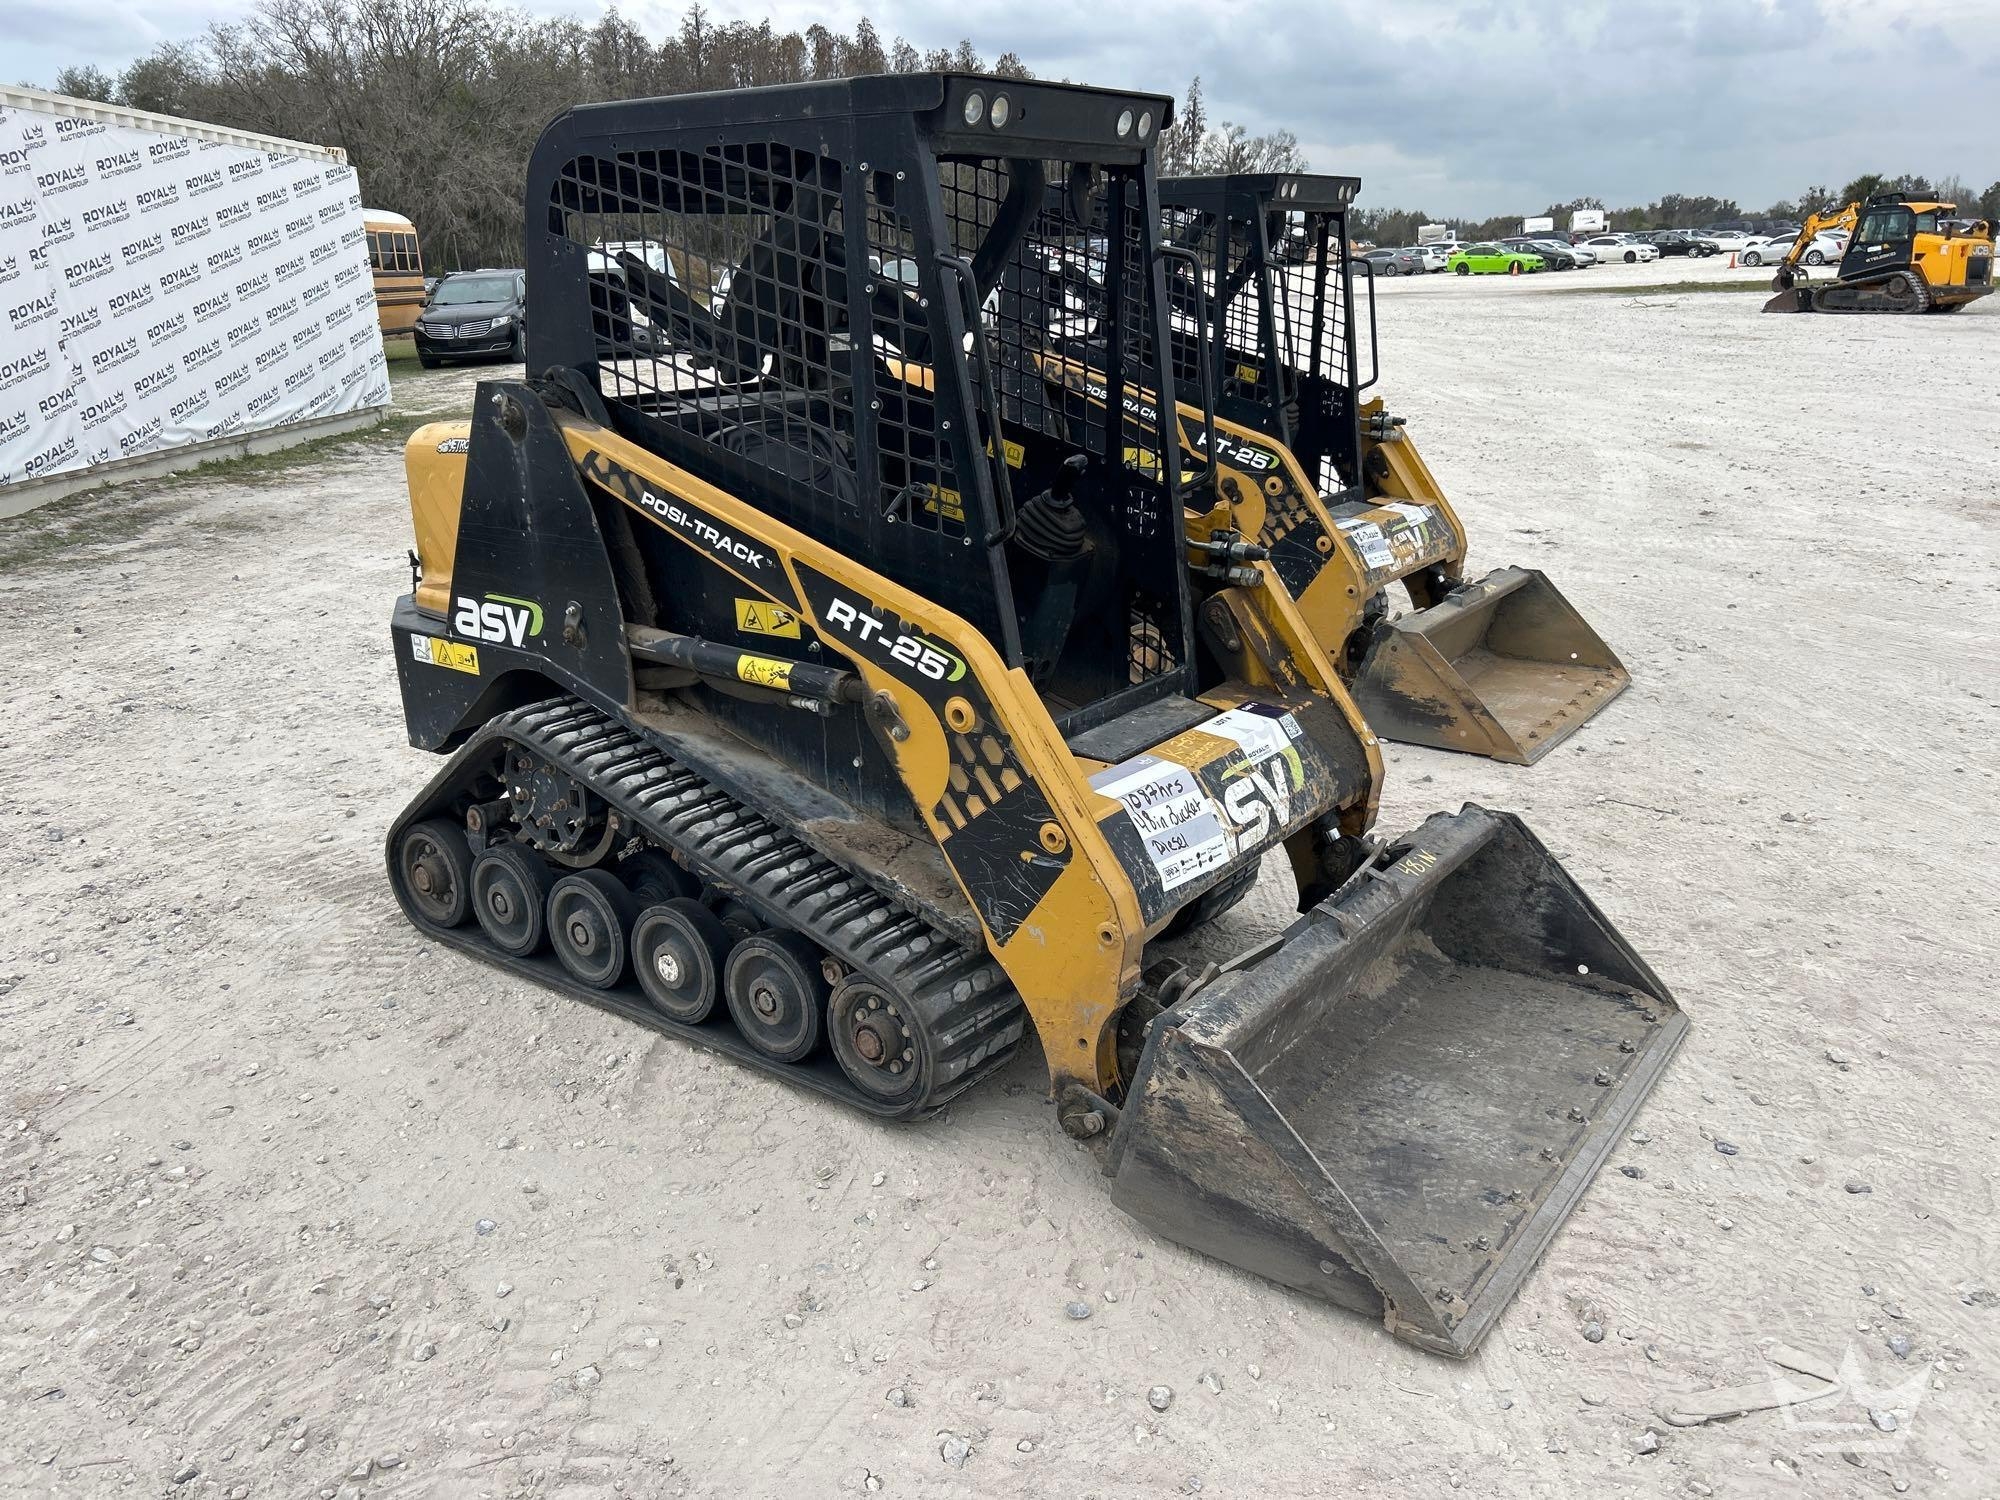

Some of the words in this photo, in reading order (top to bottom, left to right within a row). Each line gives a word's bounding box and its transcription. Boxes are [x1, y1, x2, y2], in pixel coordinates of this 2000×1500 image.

[60, 131, 86, 142] AUCTION
[87, 126, 106, 134] GROUP
[149, 140, 180, 156] ROYAL
[152, 154, 174, 164] AUCTION
[174, 150, 190, 158] GROUP
[96, 153, 131, 172] ROYAL
[100, 168, 124, 180] AUCTION
[124, 163, 142, 172] GROUP
[228, 159, 256, 176] ROYAL
[37, 168, 76, 188] ROYAL
[186, 172, 215, 190] ROYAL
[325, 165, 347, 180] ROYAL
[42, 185, 69, 198] AUCTION
[69, 178, 88, 189] GROUP
[190, 186, 209, 198] AUCTION
[209, 181, 224, 190] GROUP
[293, 177, 314, 192] ROYAL
[136, 187, 170, 206] ROYAL
[140, 201, 163, 214] AUCTION
[163, 196, 180, 205] GROUP
[257, 189, 282, 206] ROYAL
[16, 213, 36, 226] GROUP
[83, 203, 120, 224] ROYAL
[216, 204, 244, 221] ROYAL
[318, 204, 340, 218] ROYAL
[1838, 215, 1852, 224] JCB
[88, 219, 112, 232] AUCTION
[112, 212, 130, 223] GROUP
[170, 220, 202, 238] ROYAL
[286, 218, 310, 233] ROYAL
[54, 232, 75, 244] GROUP
[175, 233, 196, 246] AUCTION
[196, 228, 212, 237] GROUP
[248, 232, 274, 250] ROYAL
[341, 229, 361, 244] ROYAL
[122, 237, 154, 258] ROYAL
[126, 252, 148, 266] AUCTION
[149, 246, 165, 257] GROUP
[310, 244, 332, 259] ROYAL
[1972, 245, 1989, 255] JCB
[208, 248, 234, 268] ROYAL
[275, 259, 300, 276] ROYAL
[64, 258, 102, 280] ROYAL
[69, 273, 95, 288] AUCTION
[95, 266, 114, 278] GROUP
[160, 267, 192, 288] ROYAL
[334, 267, 356, 282] ROYAL
[164, 281, 185, 294] AUCTION
[185, 275, 202, 286] GROUP
[236, 276, 262, 296] ROYAL
[302, 283, 326, 300] ROYAL
[109, 288, 144, 310] ROYAL
[113, 303, 137, 318] AUCTION
[137, 296, 154, 308] GROUP
[193, 296, 223, 316] ROYAL
[9, 296, 52, 322] ROYAL
[197, 310, 217, 323] AUCTION
[217, 303, 232, 314] GROUP
[266, 302, 292, 320] ROYAL
[326, 308, 348, 324] ROYAL
[14, 312, 44, 331] AUCTION
[82, 320, 102, 332] GROUP
[147, 318, 178, 340] ROYAL
[152, 332, 173, 348] AUCTION
[173, 325, 188, 337] GROUP
[228, 322, 254, 341] ROYAL
[293, 326, 316, 344] ROYAL
[350, 327, 370, 346] ROYAL
[92, 342, 129, 366] ROYAL
[96, 358, 121, 375] AUCTION
[122, 350, 140, 364] GROUP
[182, 344, 213, 366] ROYAL
[186, 357, 207, 372] AUCTION
[207, 350, 222, 362] GROUP
[256, 344, 282, 366] ROYAL
[318, 346, 342, 365] ROYAL
[27, 362, 50, 378] GROUP
[214, 368, 243, 390] ROYAL
[284, 368, 310, 388] ROYAL
[341, 368, 362, 386] ROYAL
[134, 368, 168, 392] ROYAL
[138, 383, 161, 400] AUCTION
[161, 374, 178, 389] GROUP
[170, 394, 200, 418] ROYAL
[248, 391, 273, 412] ROYAL
[310, 388, 332, 410] ROYAL
[44, 403, 72, 422] AUCTION
[83, 411, 109, 430] AUCTION
[109, 402, 128, 418] GROUP
[174, 408, 195, 426] AUCTION
[195, 399, 210, 414] GROUP
[8, 424, 30, 442] GROUP
[120, 422, 154, 449] ROYAL
[206, 416, 234, 439] ROYAL
[123, 437, 146, 456] AUCTION
[147, 428, 164, 444] GROUP
[24, 444, 66, 474] ROYAL
[57, 450, 79, 467] GROUP
[641, 491, 764, 570] POSI-TRACK
[826, 598, 950, 680] RT-25
